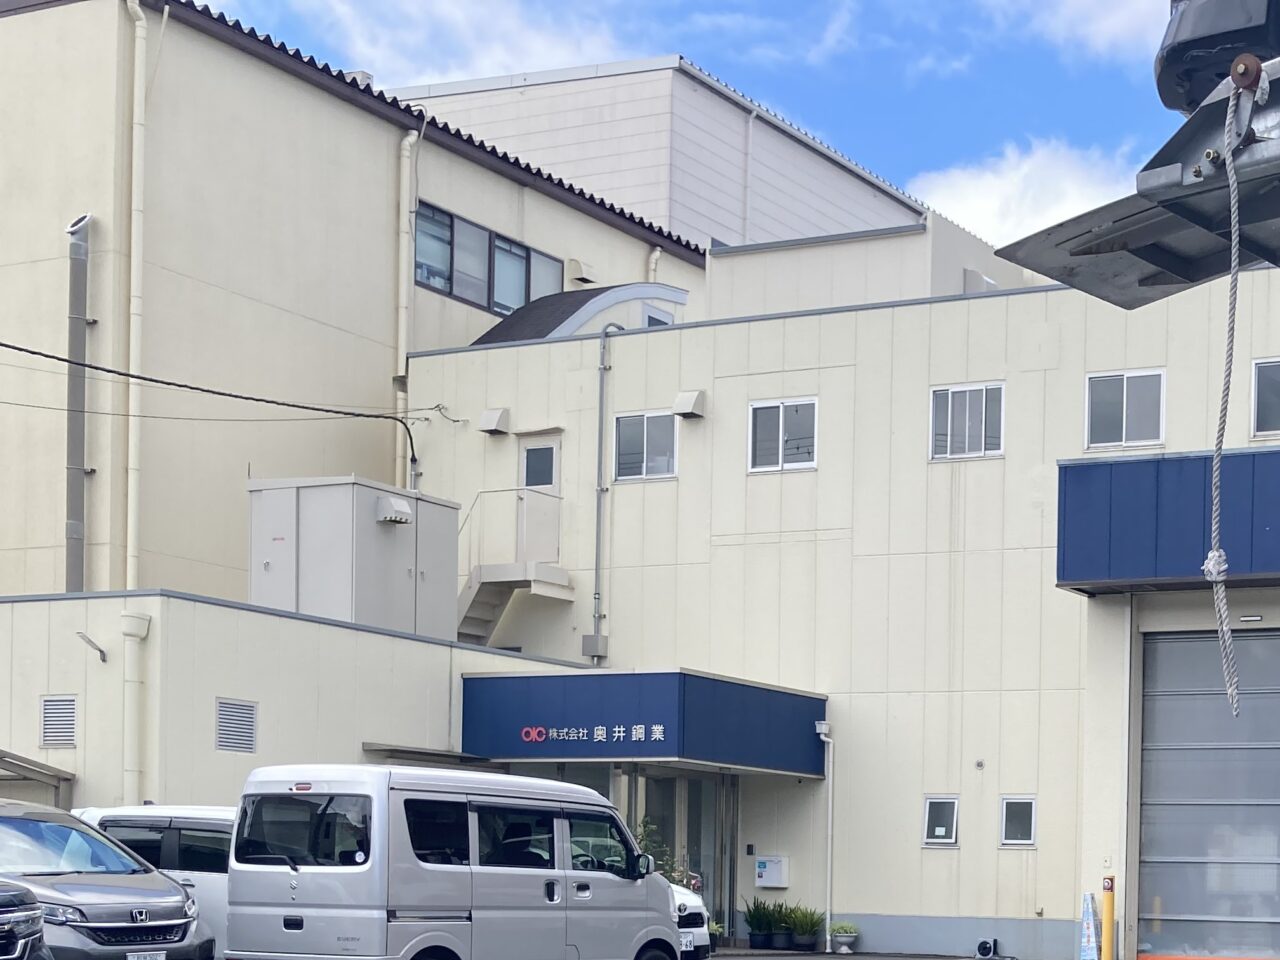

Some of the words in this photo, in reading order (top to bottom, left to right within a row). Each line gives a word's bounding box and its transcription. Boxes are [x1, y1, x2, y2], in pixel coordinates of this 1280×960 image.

[549, 728, 589, 741] 株式会社
[593, 724, 665, 742] 奥井鋼業
